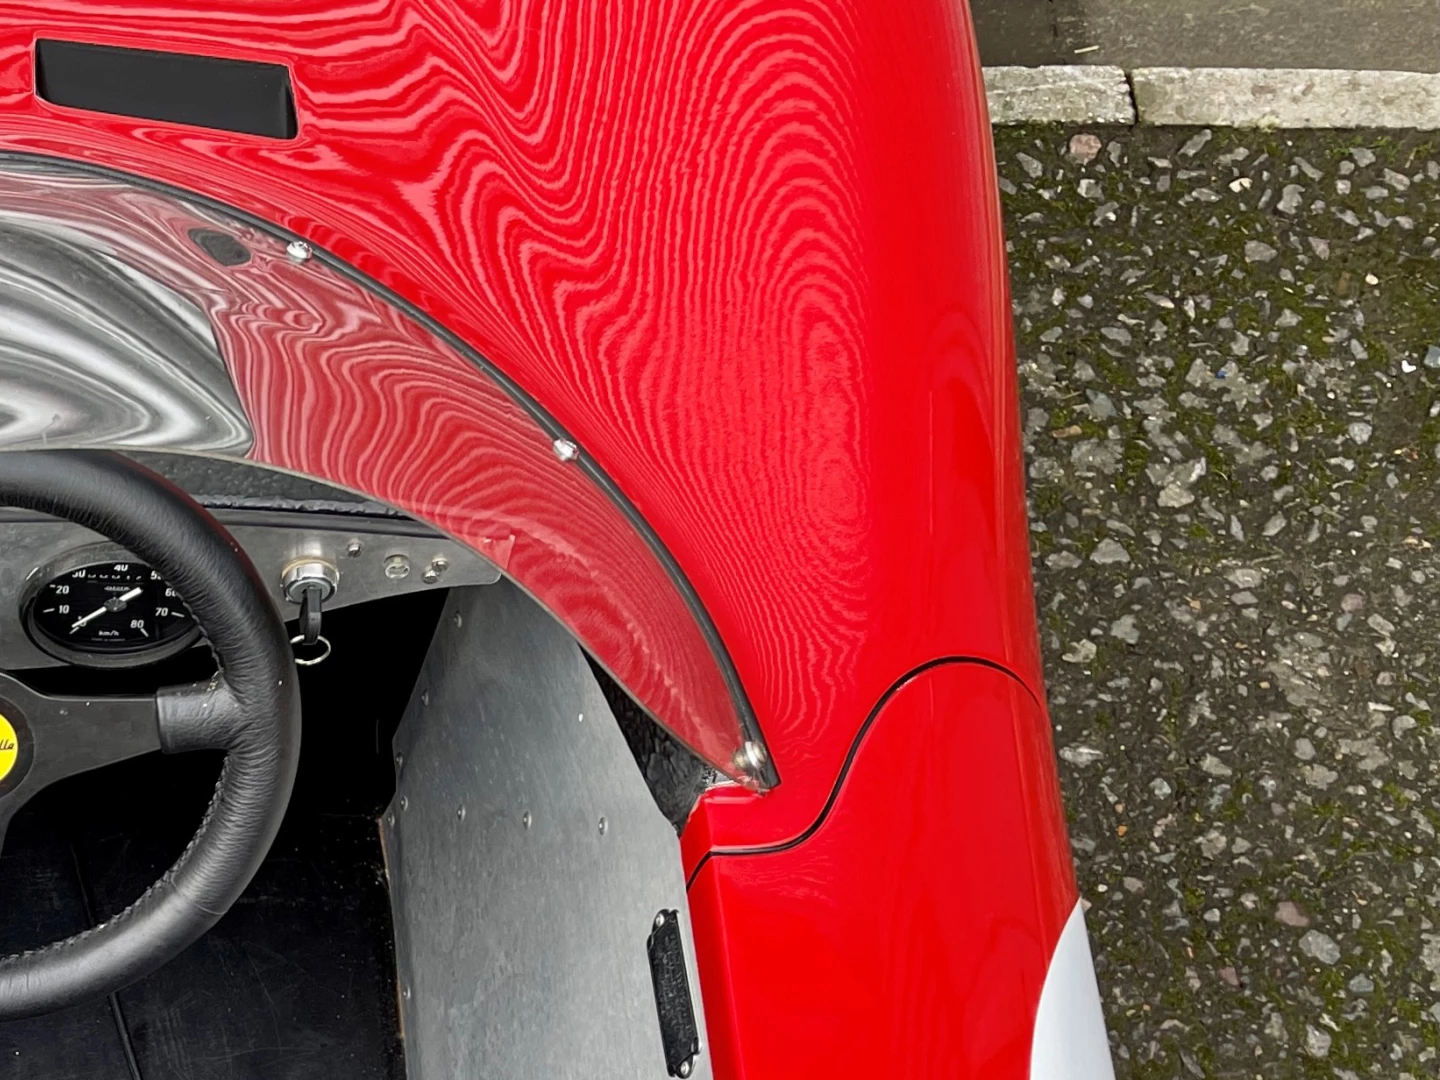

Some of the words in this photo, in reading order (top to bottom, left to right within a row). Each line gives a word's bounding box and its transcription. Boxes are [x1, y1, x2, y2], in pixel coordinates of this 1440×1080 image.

[114, 564, 129, 572] 40
[150, 571, 161, 580] 5
[56, 585, 70, 595] 20
[59, 605, 70, 615] 10
[155, 607, 169, 617] 70
[130, 619, 145, 629] 80
